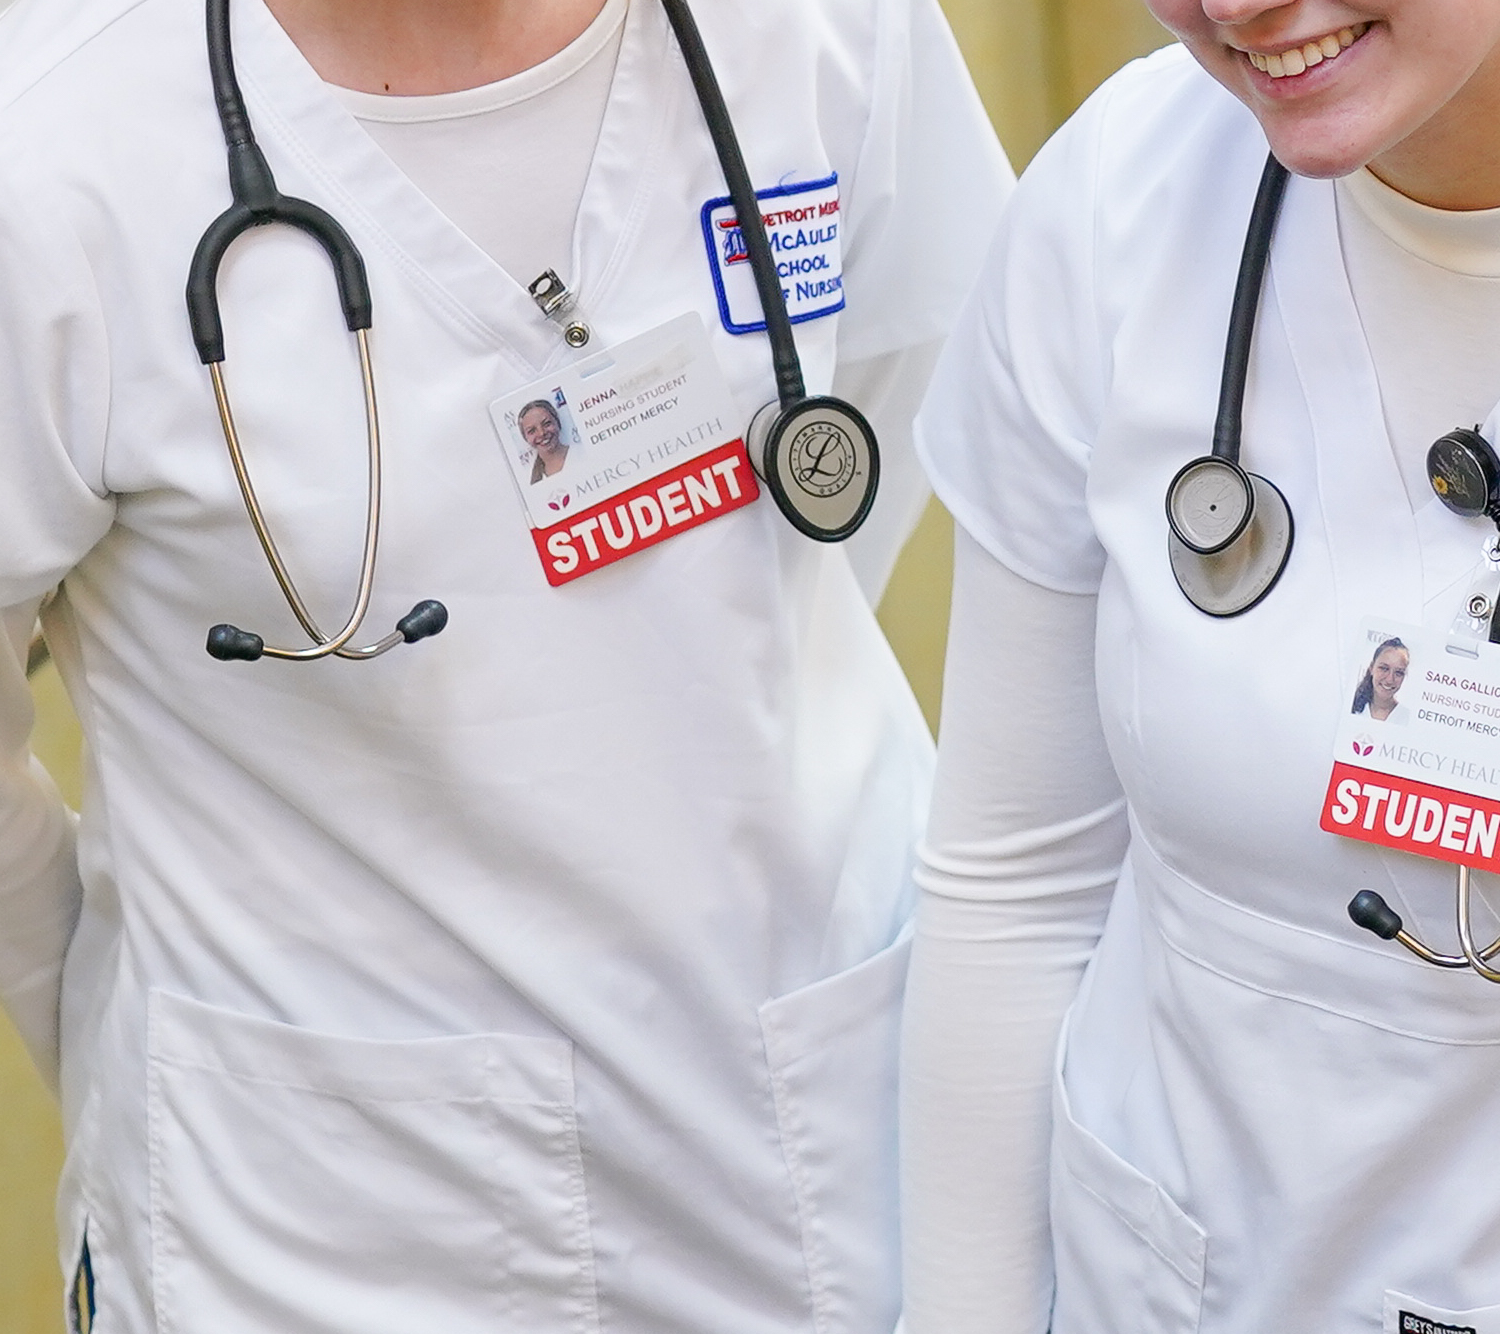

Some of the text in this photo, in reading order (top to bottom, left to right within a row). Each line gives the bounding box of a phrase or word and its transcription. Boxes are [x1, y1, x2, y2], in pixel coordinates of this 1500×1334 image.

[777, 254, 830, 278] CHOOL
[577, 388, 618, 413] JENNA
[585, 398, 635, 429] NURSING
[636, 374, 687, 405] STUDENT
[590, 416, 638, 445] DETROIT
[641, 397, 680, 423] MERCY
[575, 417, 723, 498] MERCY HEALTH
[546, 455, 741, 574] STUDENT
[1425, 670, 1457, 687] SARA
[1422, 691, 1471, 712] NURSING
[1418, 709, 1465, 729] DETROIT
[1379, 742, 1449, 771] MERCY
